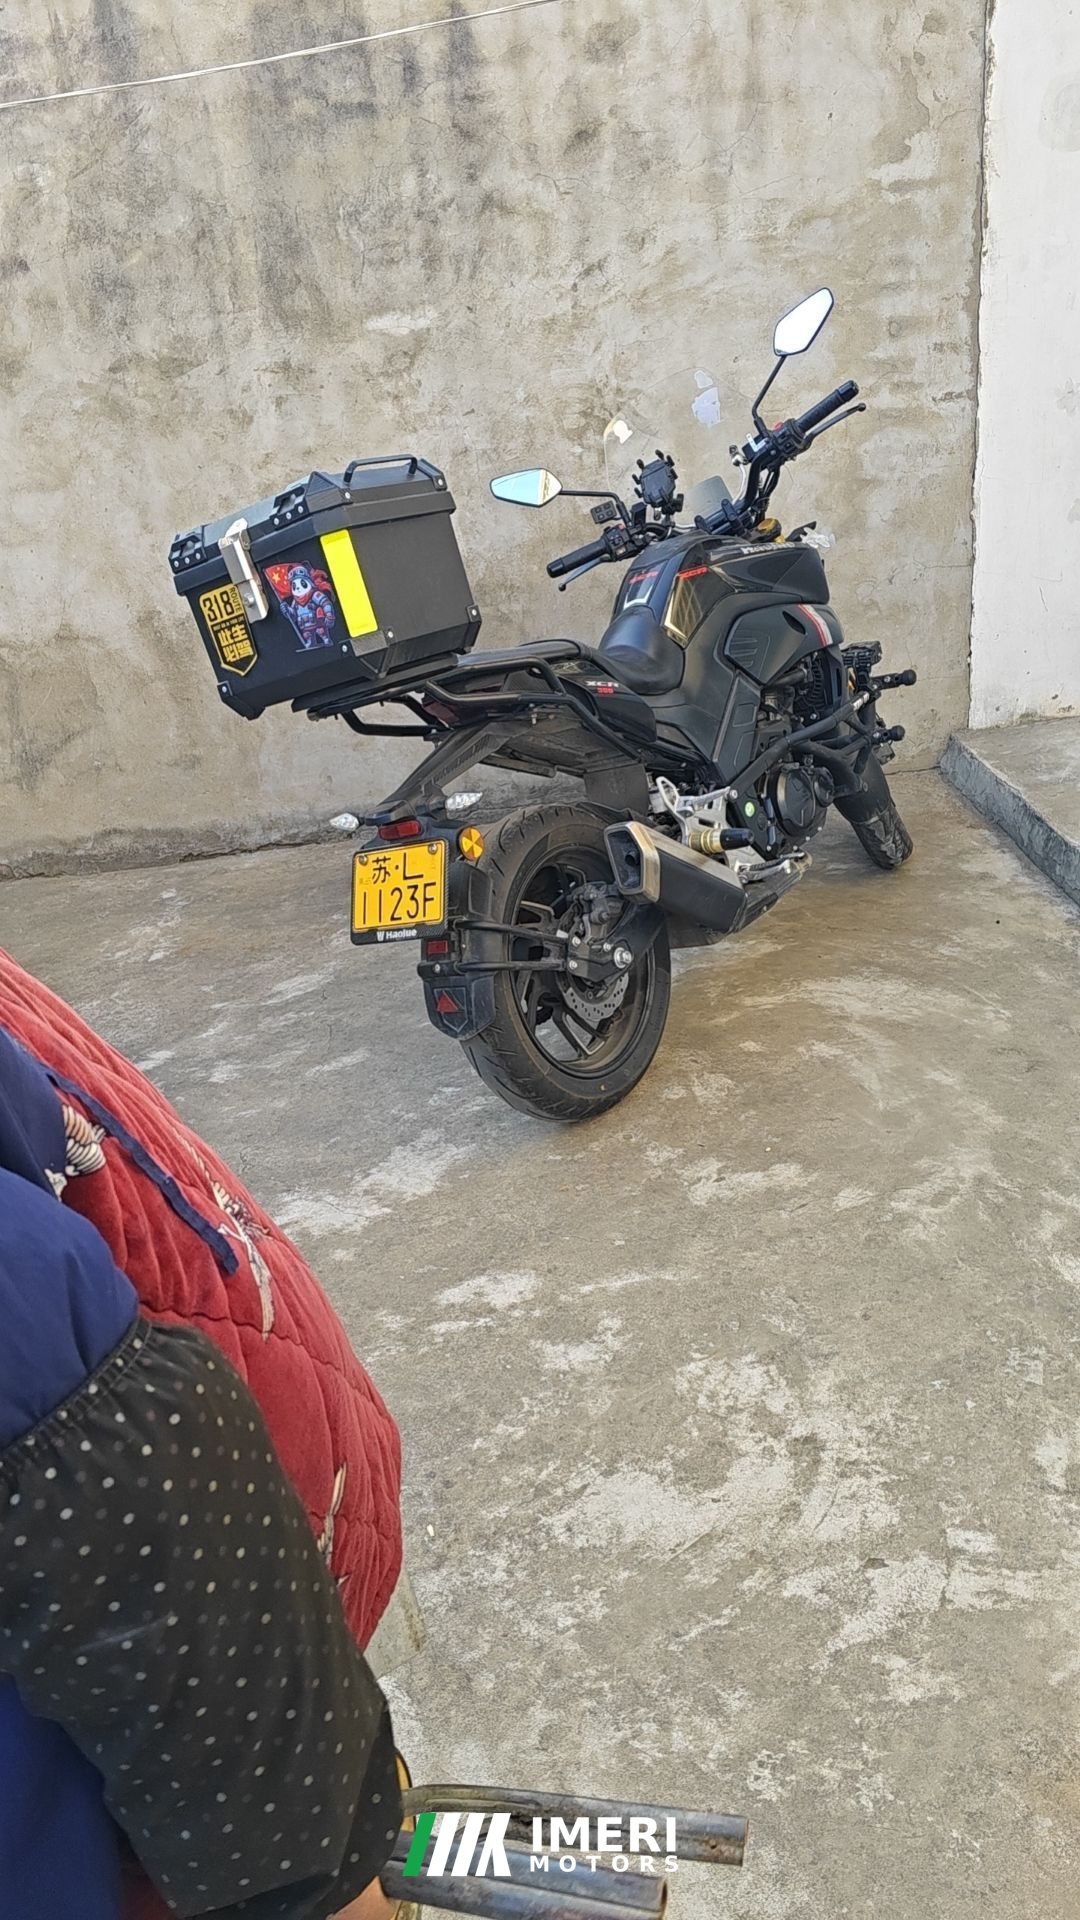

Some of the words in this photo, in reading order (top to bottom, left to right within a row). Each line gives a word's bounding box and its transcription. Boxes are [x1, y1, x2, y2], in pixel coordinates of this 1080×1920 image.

[202, 590, 235, 622] 318
[229, 587, 243, 613] ROUTE
[363, 882, 437, 925] 1123F
